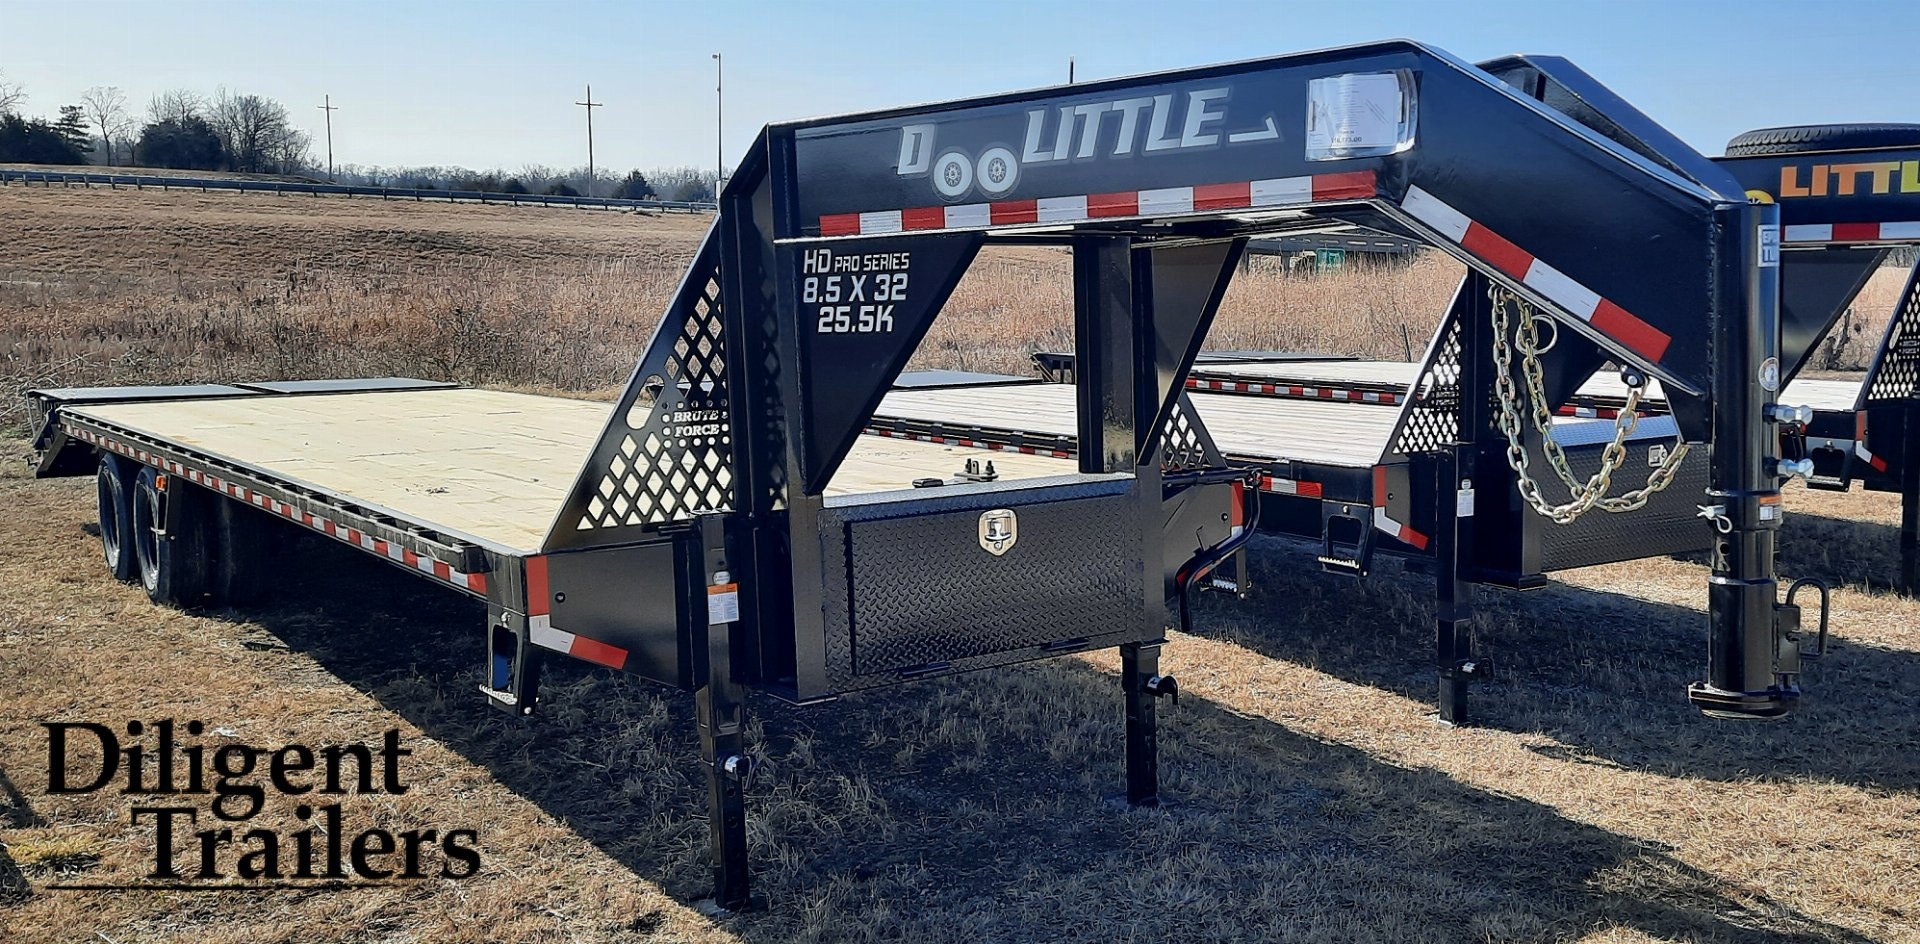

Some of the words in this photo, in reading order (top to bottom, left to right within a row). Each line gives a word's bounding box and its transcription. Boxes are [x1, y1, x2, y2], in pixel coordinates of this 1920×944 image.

[803, 248, 832, 274] HD
[834, 255, 861, 272] PRO
[863, 252, 910, 272] SERIES
[802, 275, 842, 303] 8.5
[848, 274, 867, 302] X
[874, 272, 909, 301] 32
[818, 304, 894, 333] 25.5K
[673, 410, 719, 423] BRUTE
[674, 423, 720, 437] FORCE
